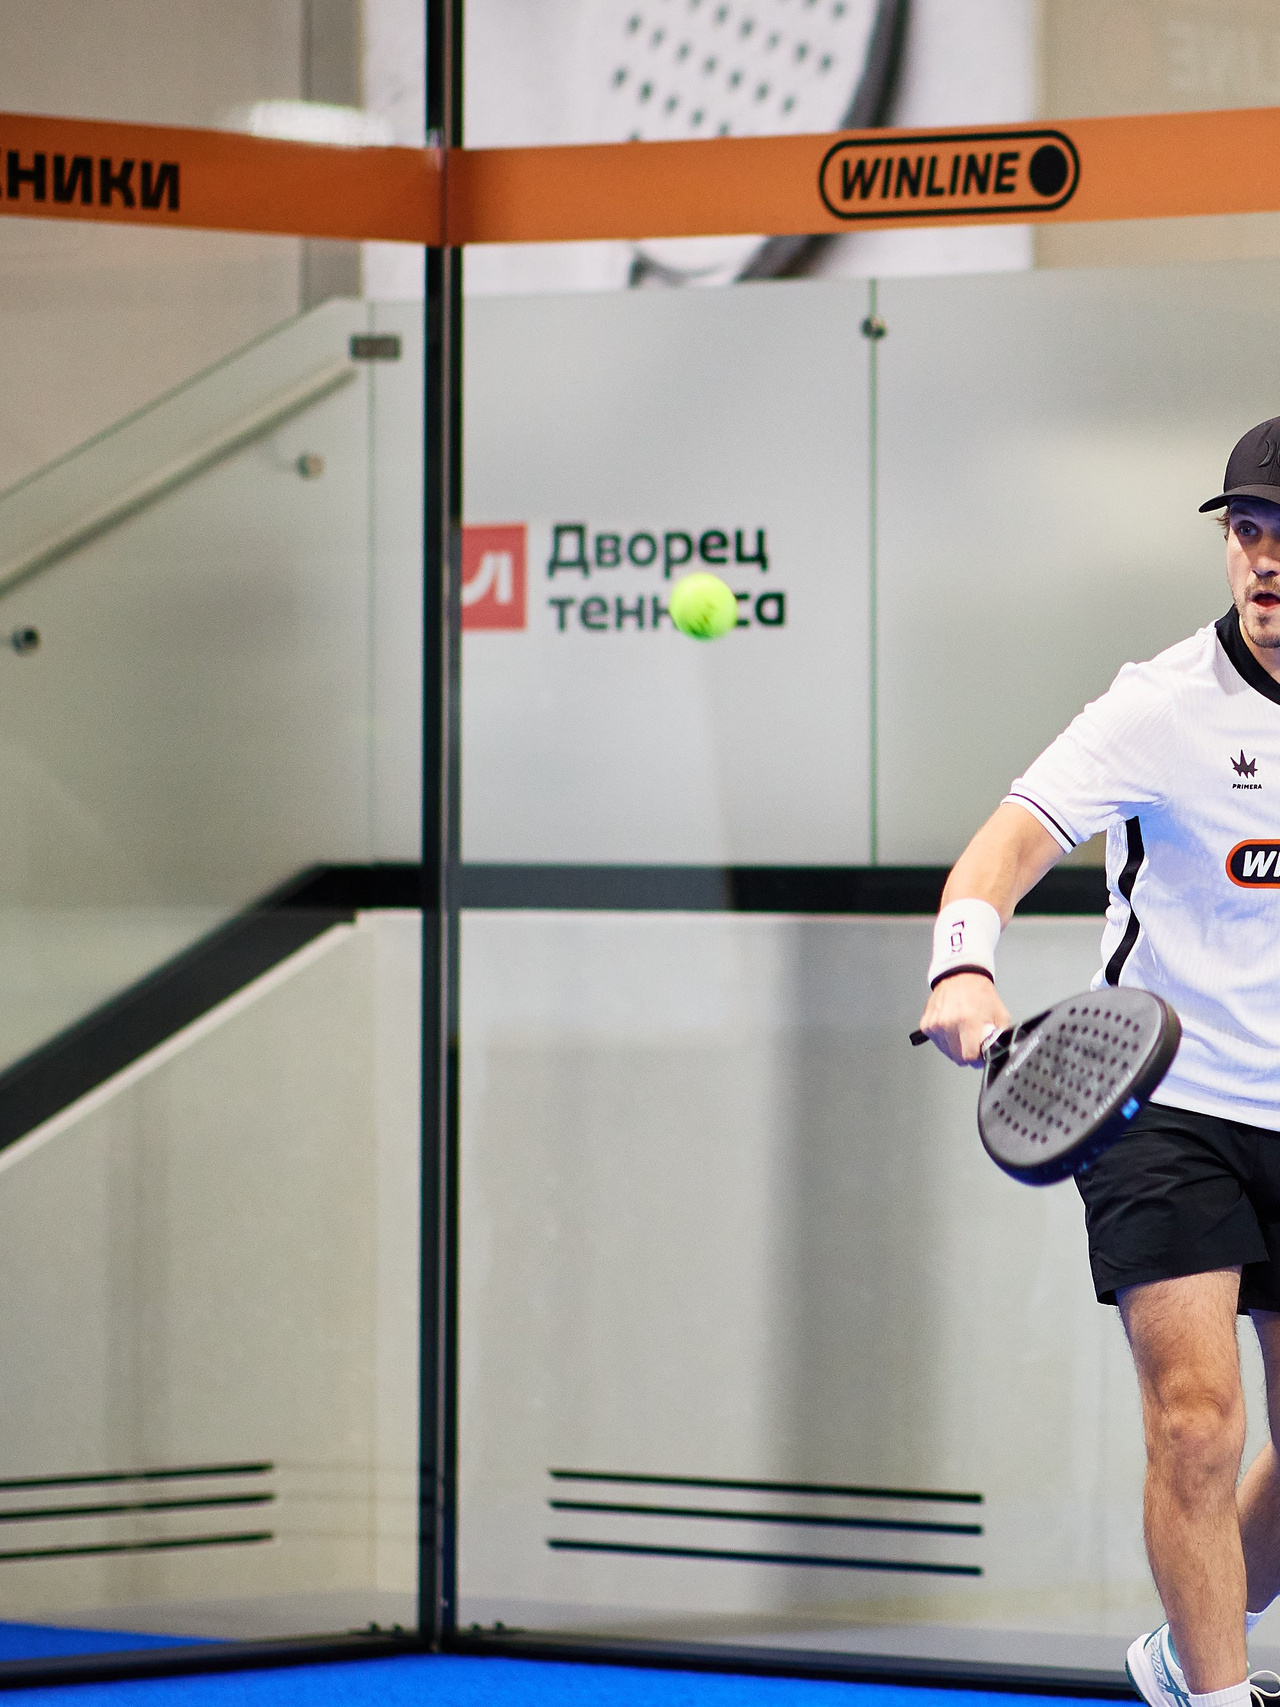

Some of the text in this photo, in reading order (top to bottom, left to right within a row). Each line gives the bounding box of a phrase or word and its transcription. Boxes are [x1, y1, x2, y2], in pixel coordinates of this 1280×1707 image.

[0, 151, 180, 212] НИКИ
[841, 152, 1020, 200] WINLINE
[547, 523, 768, 580] Дворец
[549, 592, 786, 632] теннса
